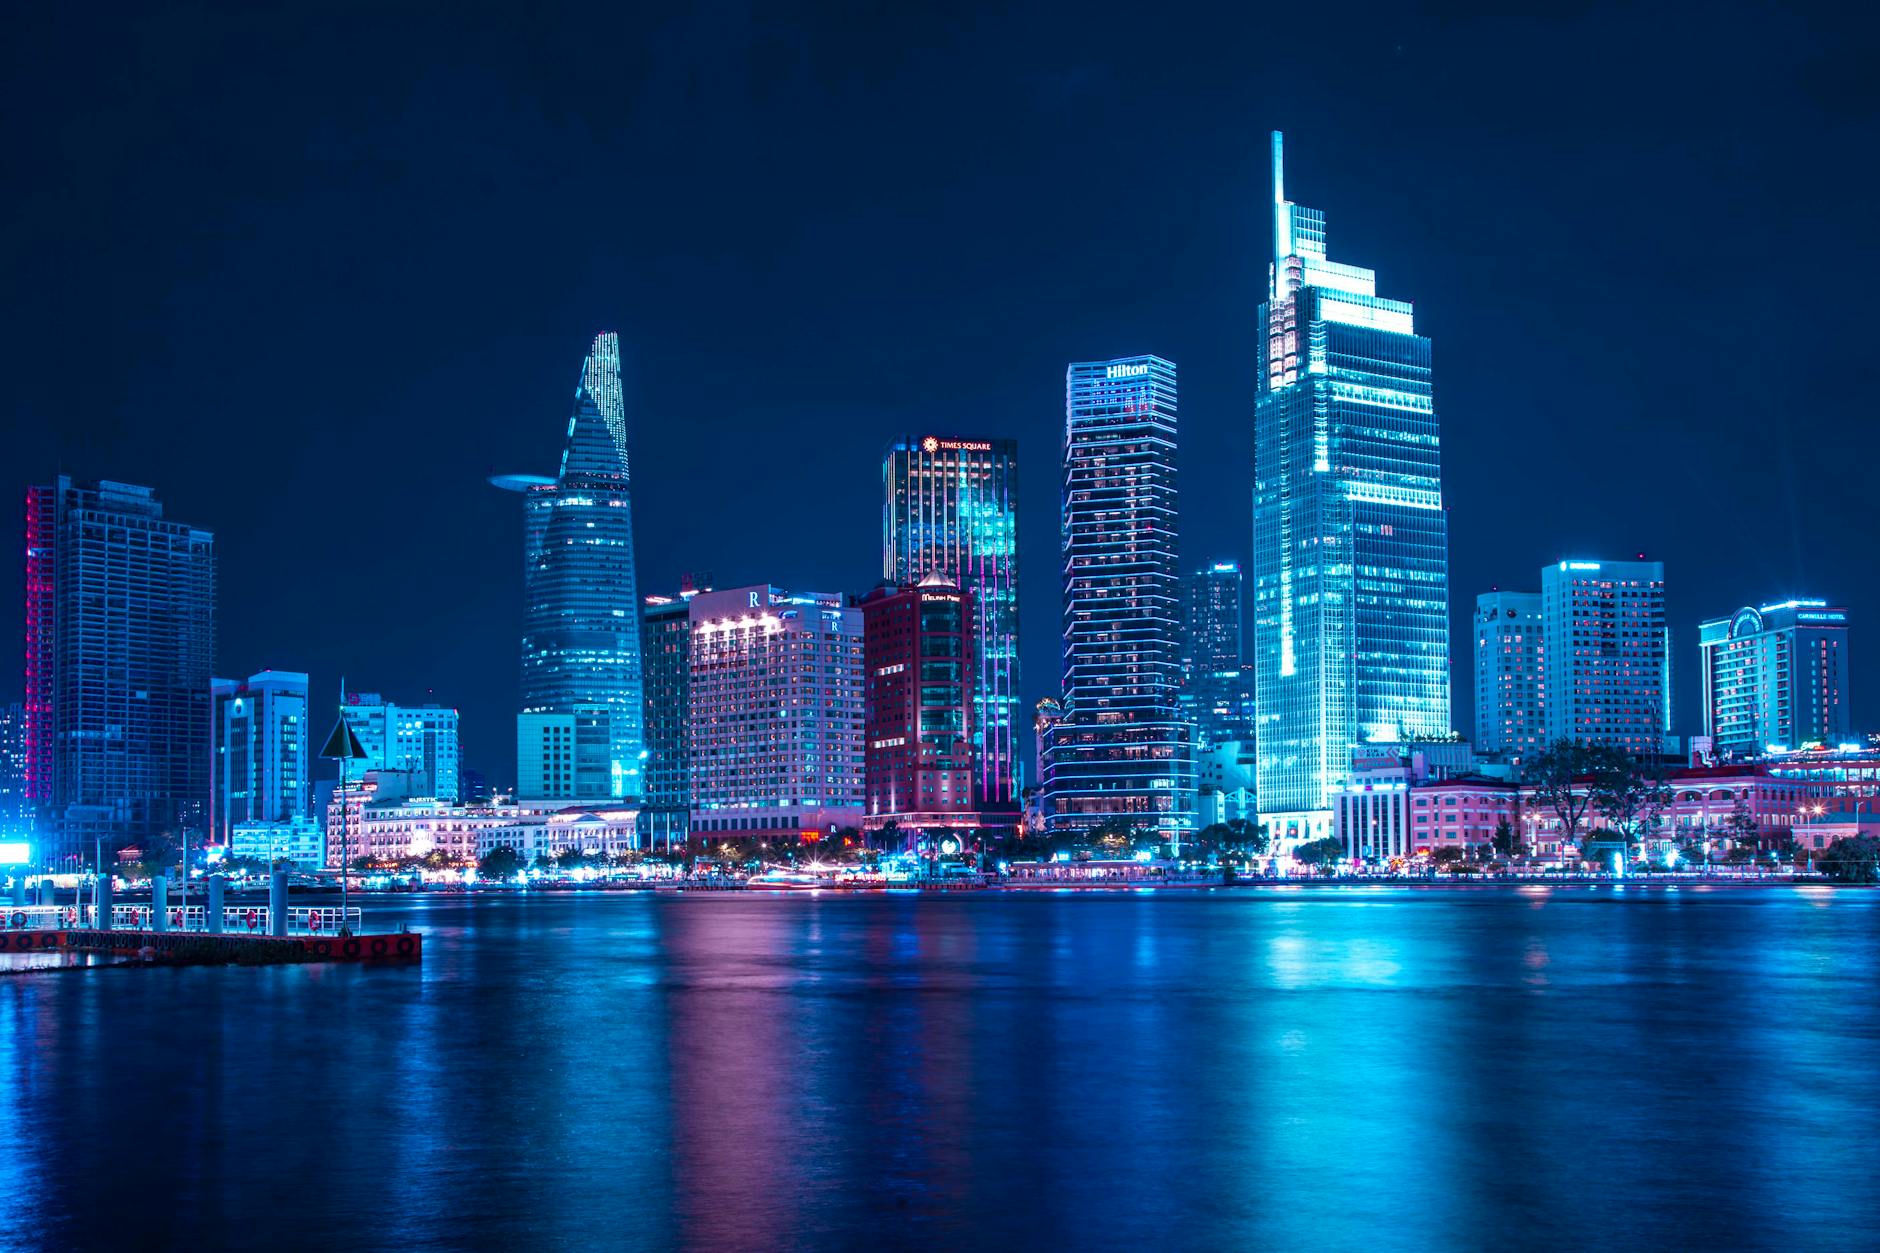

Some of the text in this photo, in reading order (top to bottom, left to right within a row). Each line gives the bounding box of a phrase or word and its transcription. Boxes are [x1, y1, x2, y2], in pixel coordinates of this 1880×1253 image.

[1106, 364, 1148, 378] Hilton
[962, 442, 991, 450] SQUARE
[749, 591, 761, 608] R
[831, 621, 838, 631] R
[830, 824, 837, 833] R
